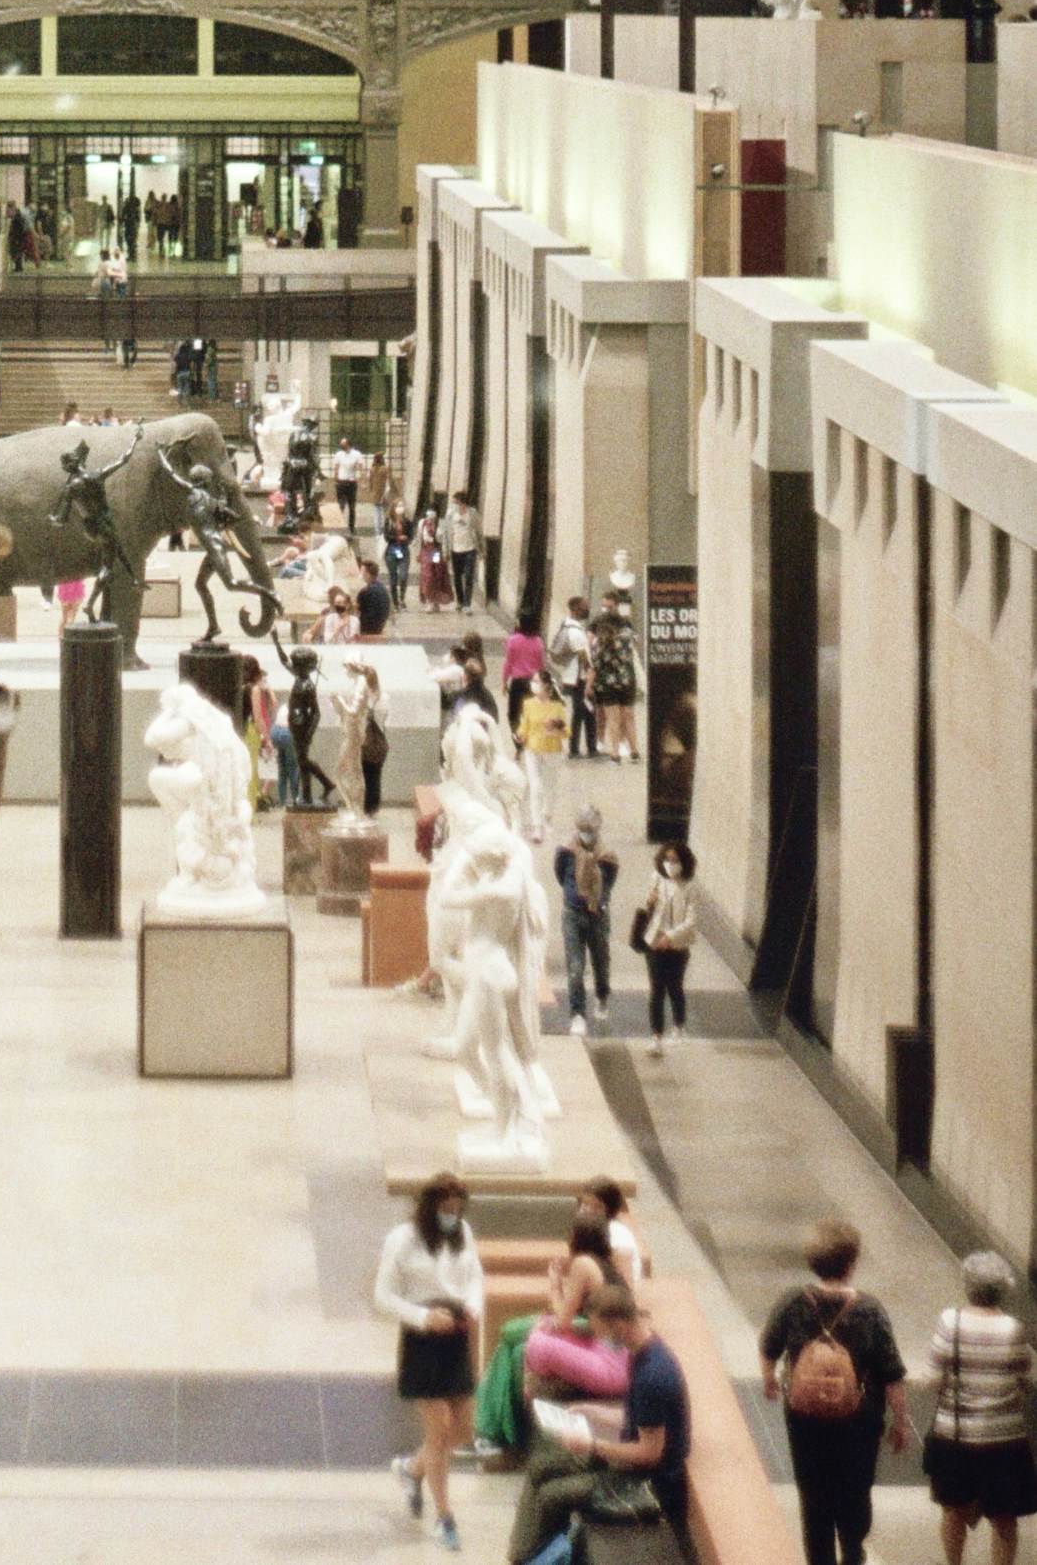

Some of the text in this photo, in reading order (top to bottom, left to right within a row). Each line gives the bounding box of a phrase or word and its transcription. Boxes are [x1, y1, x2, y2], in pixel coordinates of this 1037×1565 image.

[651, 608, 676, 623] LES
[651, 624, 698, 640] DU MO
